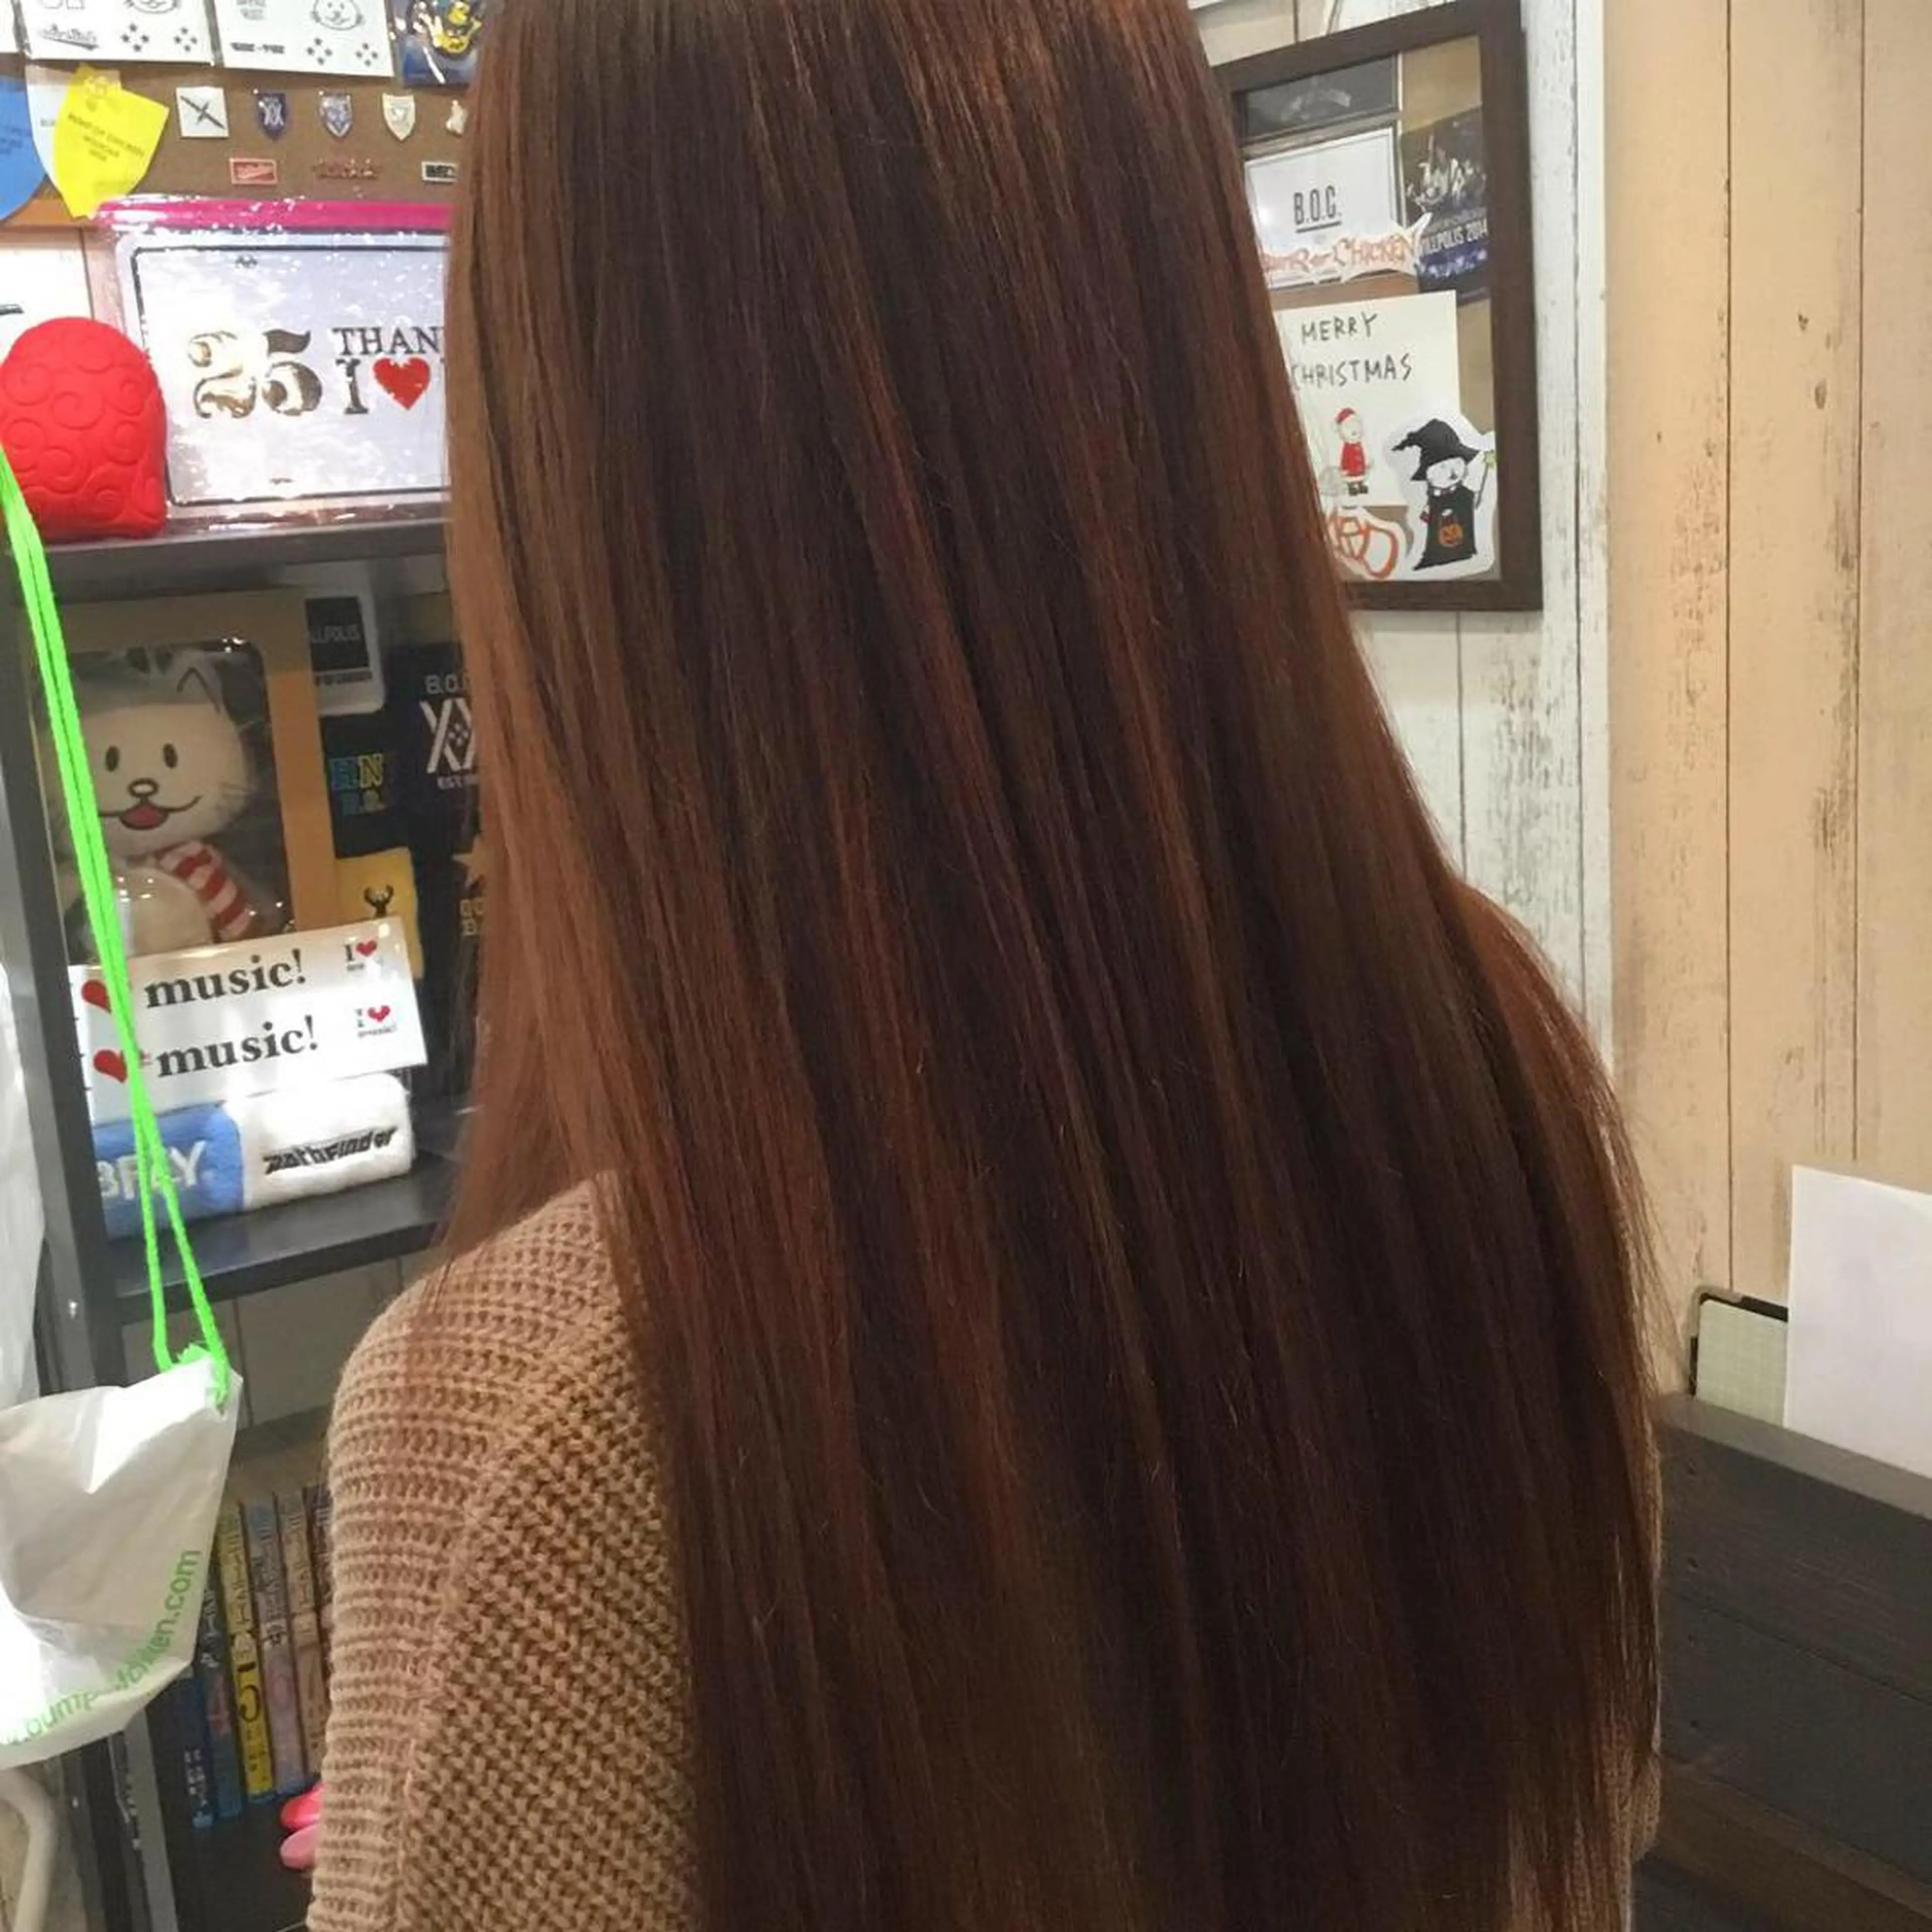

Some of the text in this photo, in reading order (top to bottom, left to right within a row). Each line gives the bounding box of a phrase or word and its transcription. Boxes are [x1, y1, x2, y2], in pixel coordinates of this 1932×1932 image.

[1294, 185, 1342, 226] B.O.C.
[1301, 311, 1379, 344] MERRY
[145, 948, 306, 1008] music!
[157, 1015, 319, 1078] music!
